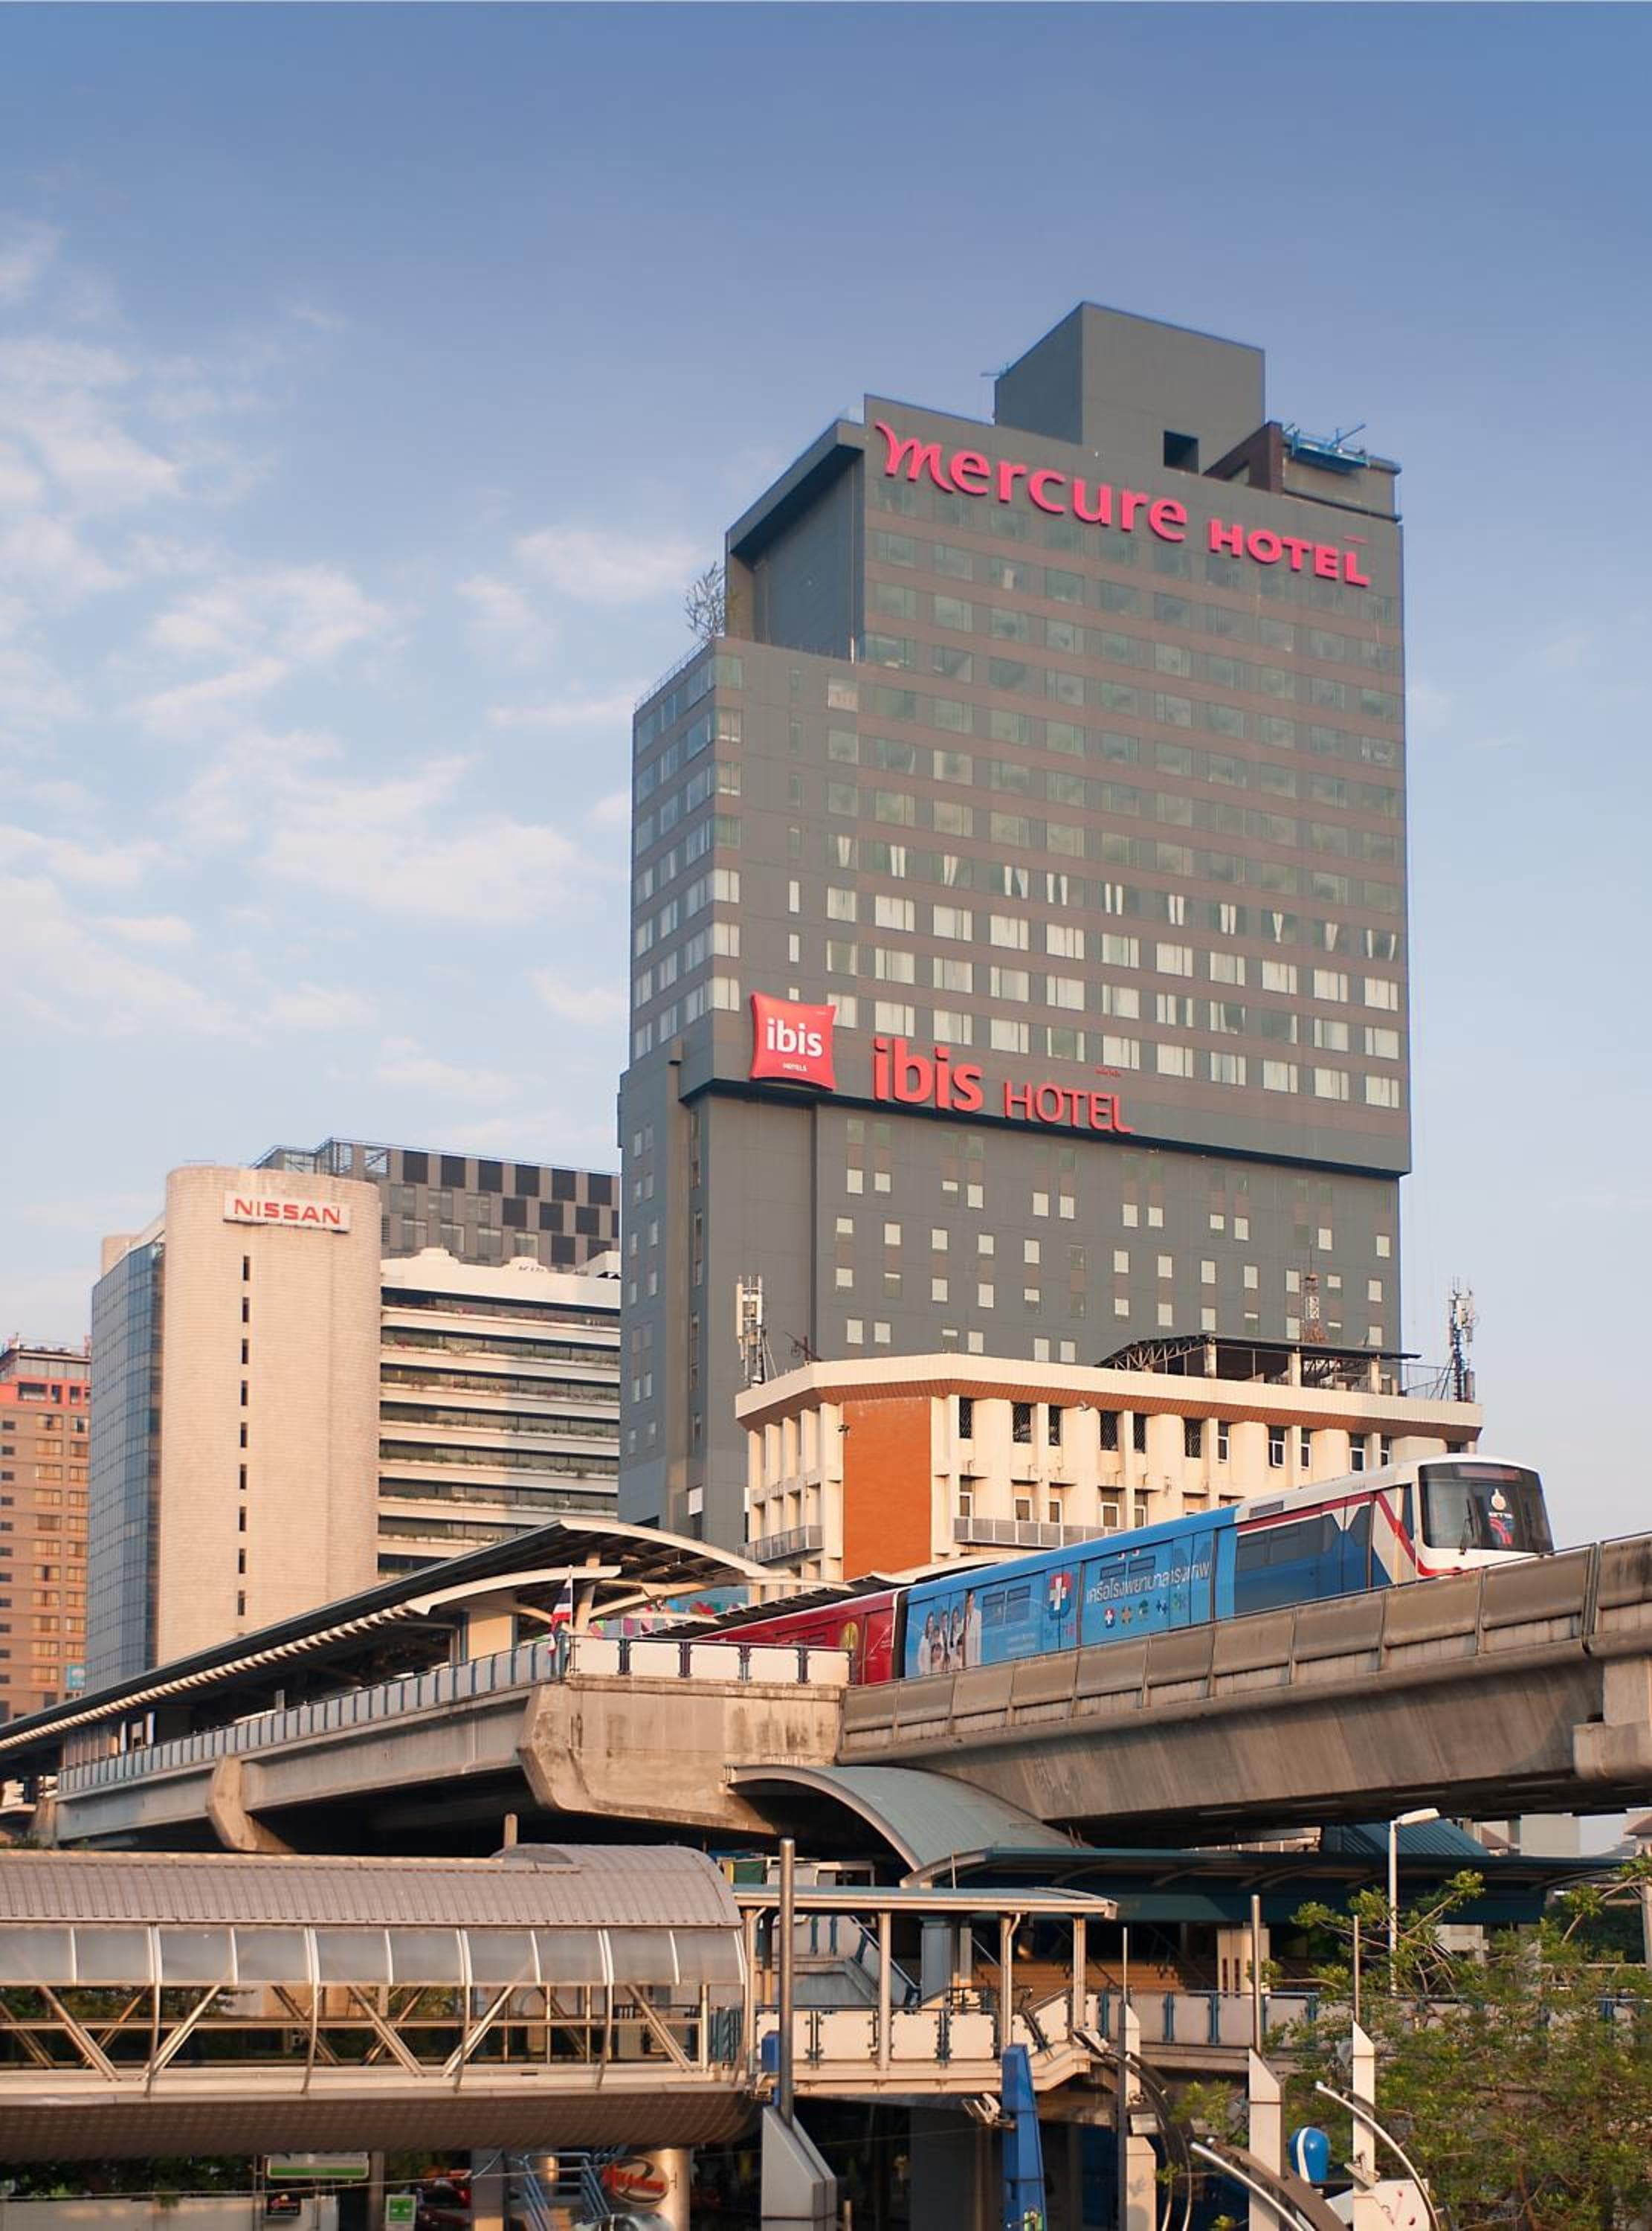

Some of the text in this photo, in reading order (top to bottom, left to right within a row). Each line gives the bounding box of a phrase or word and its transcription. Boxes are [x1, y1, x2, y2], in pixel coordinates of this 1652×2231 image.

[1207, 518, 1369, 587] HOTEL
[767, 1016, 823, 1057] ibis
[873, 1037, 1135, 1133] ibis HOTEL
[233, 1197, 342, 1225] NISSAN
